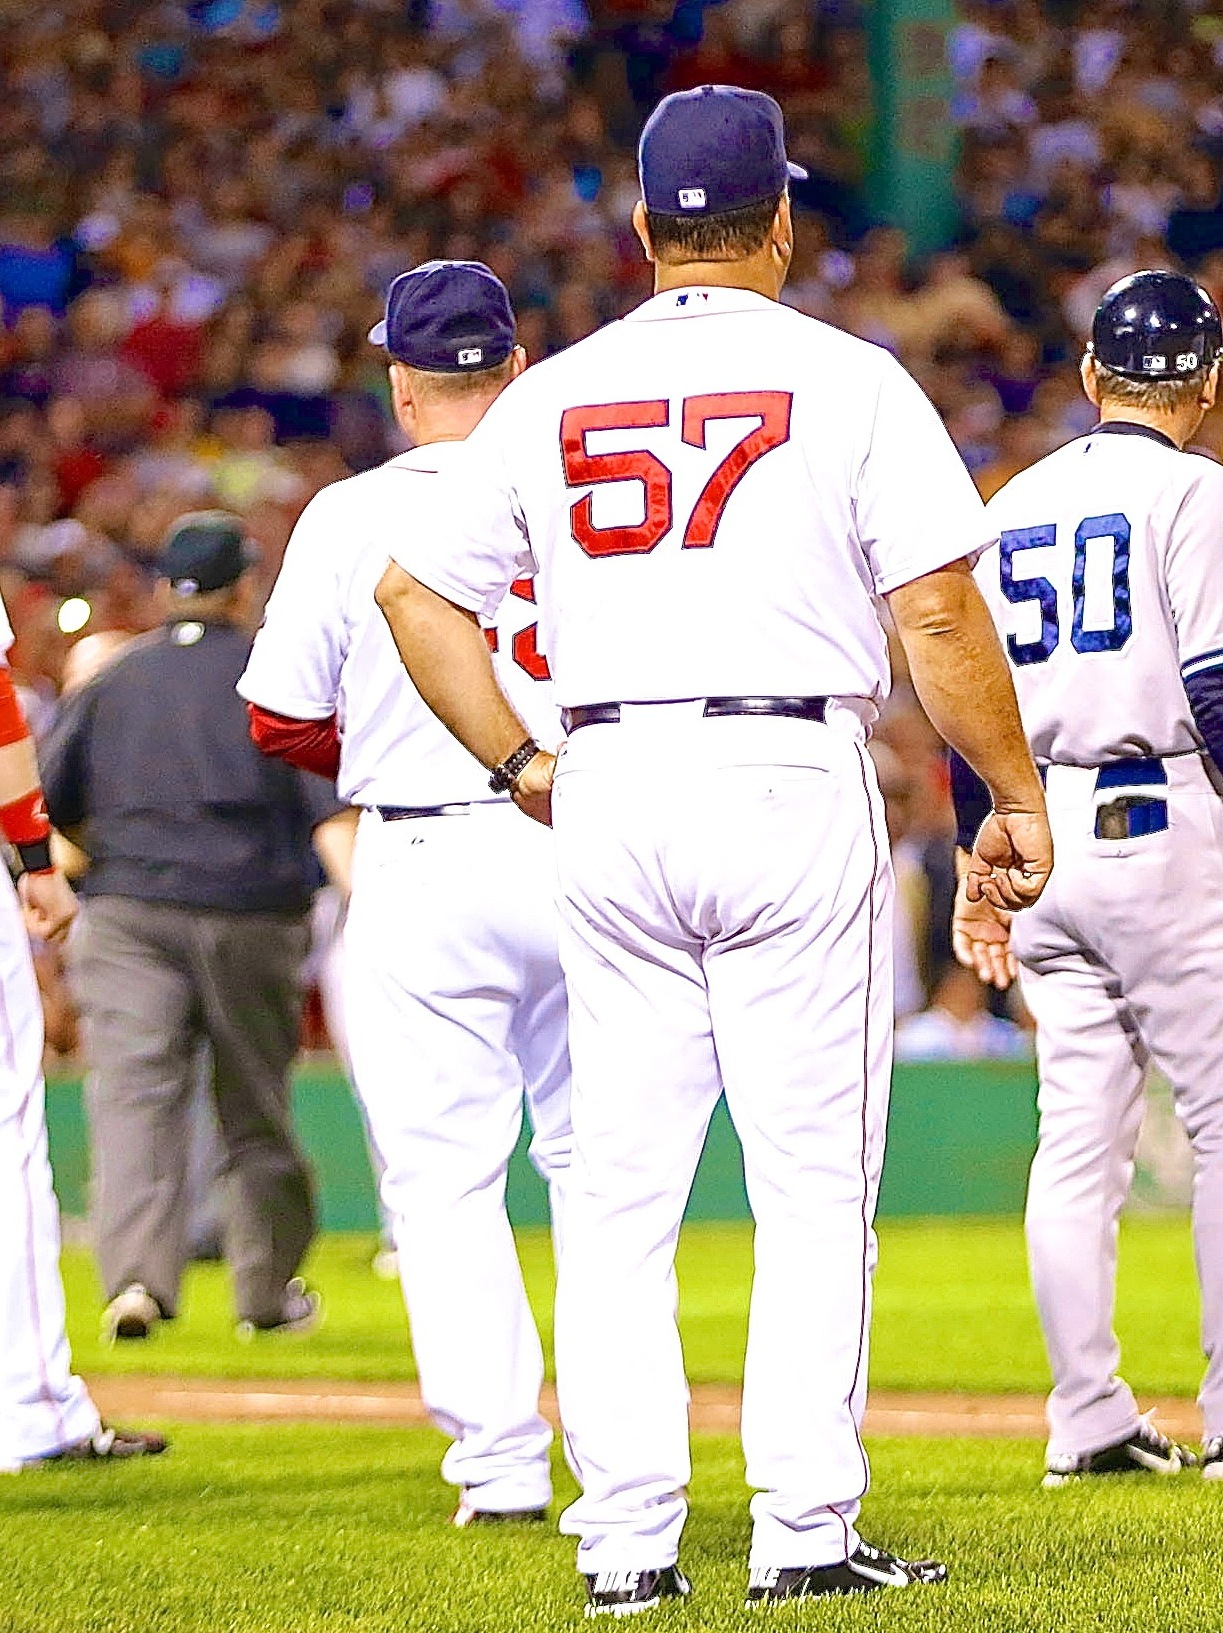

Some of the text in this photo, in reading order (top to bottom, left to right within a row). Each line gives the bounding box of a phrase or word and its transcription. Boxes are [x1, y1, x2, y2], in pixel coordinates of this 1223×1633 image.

[1176, 352, 1198, 371] 50
[559, 390, 794, 559] 57
[999, 512, 1133, 667] 50
